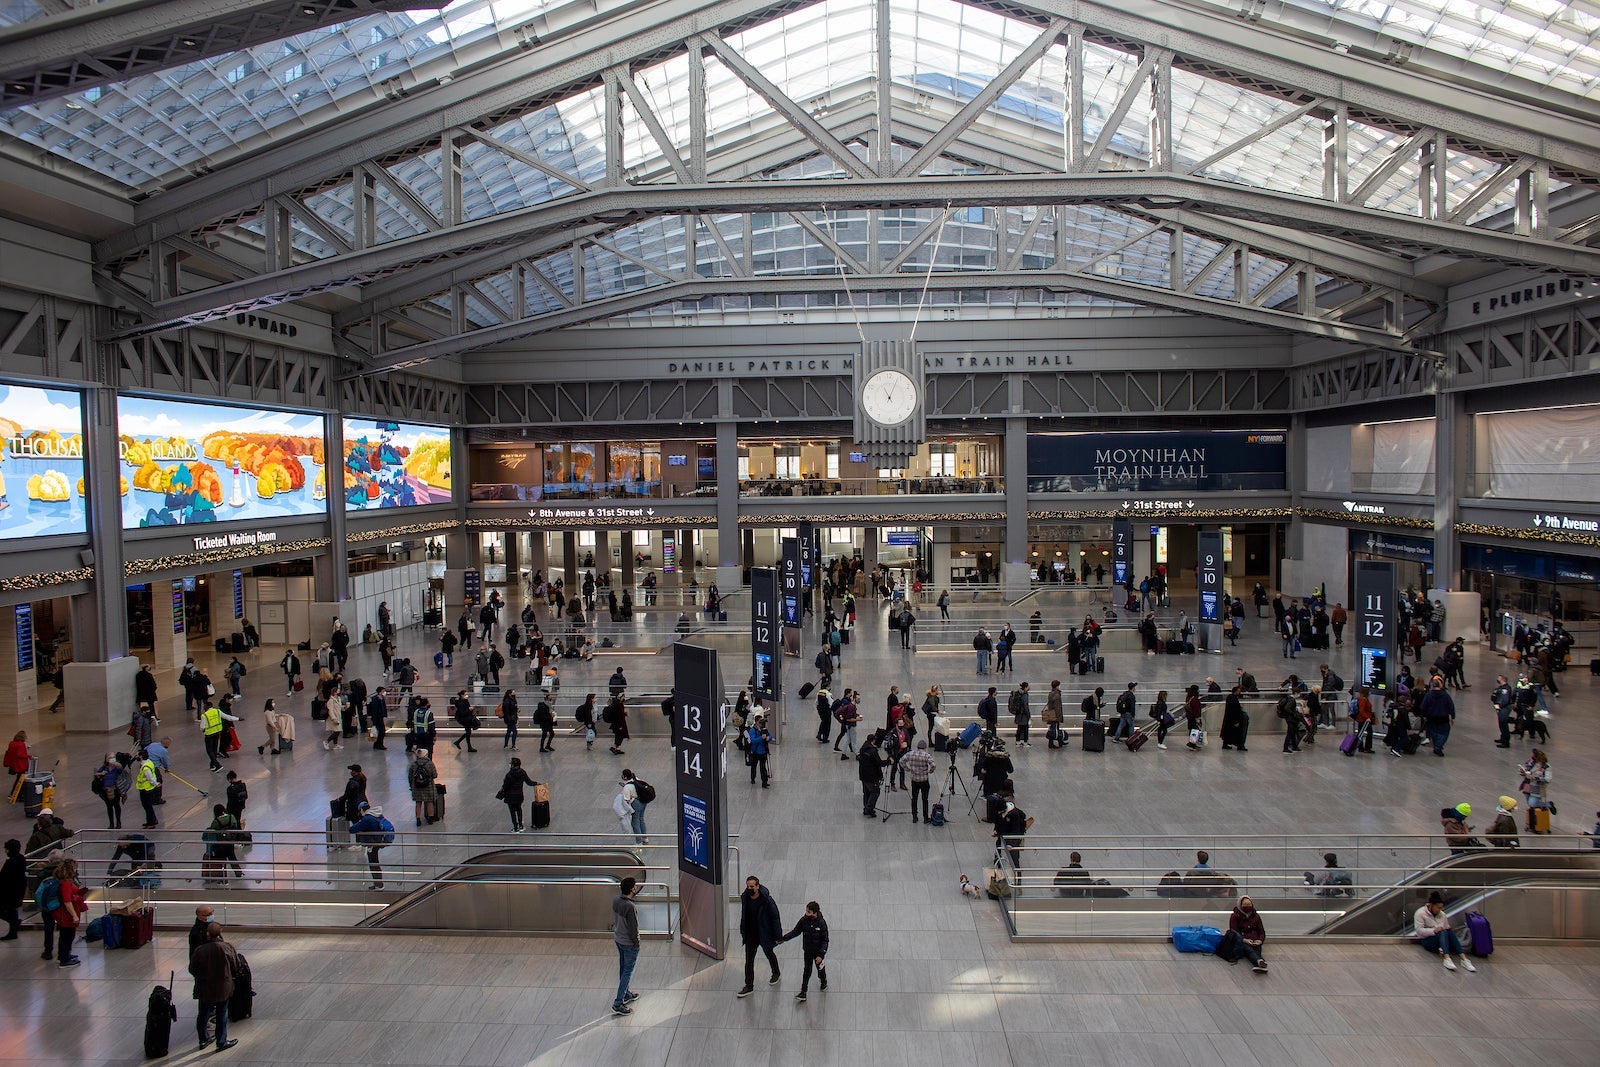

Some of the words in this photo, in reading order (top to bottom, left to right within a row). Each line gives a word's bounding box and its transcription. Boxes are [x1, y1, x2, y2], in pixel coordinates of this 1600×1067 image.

[1472, 301, 1480, 315] E
[236, 313, 297, 338] UPWARD
[669, 361, 736, 373] DANIEL
[748, 359, 830, 371] PATRICK
[957, 356, 1015, 367] TRAIN
[1028, 355, 1073, 365] HALL
[151, 442, 198, 459] ISLANDS
[1095, 448, 1205, 464] MOYNIHAN
[1093, 465, 1153, 480] TRAIN
[1160, 464, 1208, 479] HALL
[1133, 500, 1153, 509] 31st
[1154, 500, 1183, 509] Street
[1353, 505, 1385, 514] AMTRAK
[539, 508, 554, 517] 8th
[555, 508, 586, 517] Avenue
[588, 508, 595, 517] &
[597, 508, 615, 517] 31st
[616, 507, 643, 516] Street
[1545, 515, 1560, 528] 9th
[1562, 516, 1598, 532] Avenue
[193, 534, 228, 550] Ticketed
[228, 532, 256, 545] Waiting
[256, 531, 277, 543] Room
[802, 537, 808, 546] 7
[1117, 533, 1124, 542] 7
[803, 550, 809, 560] 8
[1117, 546, 1124, 556] 8
[786, 559, 794, 571] 9
[1205, 554, 1214, 566] 9
[785, 577, 796, 589] 10
[1204, 572, 1216, 584] 10
[757, 600, 768, 618] 11
[1366, 594, 1382, 611] 11
[756, 626, 769, 643] 12
[1365, 620, 1384, 637] 12
[682, 703, 701, 732] 13
[682, 749, 703, 779] 14
